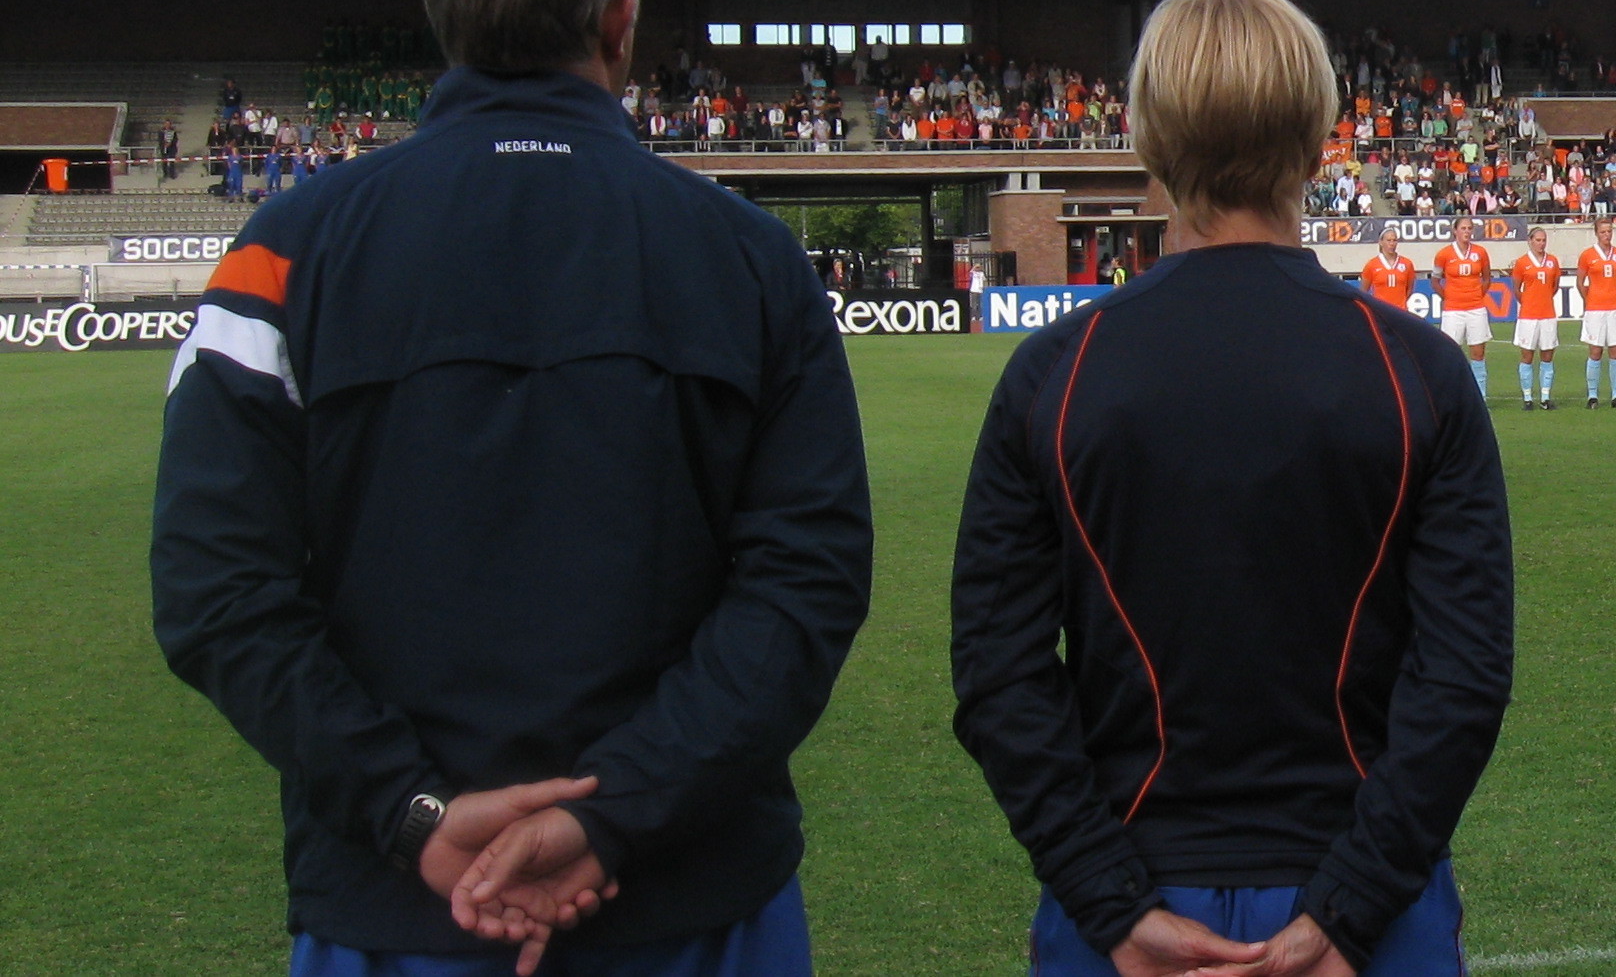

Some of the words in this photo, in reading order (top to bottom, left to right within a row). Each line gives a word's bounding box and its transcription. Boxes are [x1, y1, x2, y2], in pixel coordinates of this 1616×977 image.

[494, 139, 572, 155] NEDERLAND
[1459, 263, 1471, 276] 10
[1388, 274, 1396, 287] 11
[826, 290, 961, 333] Rexona
